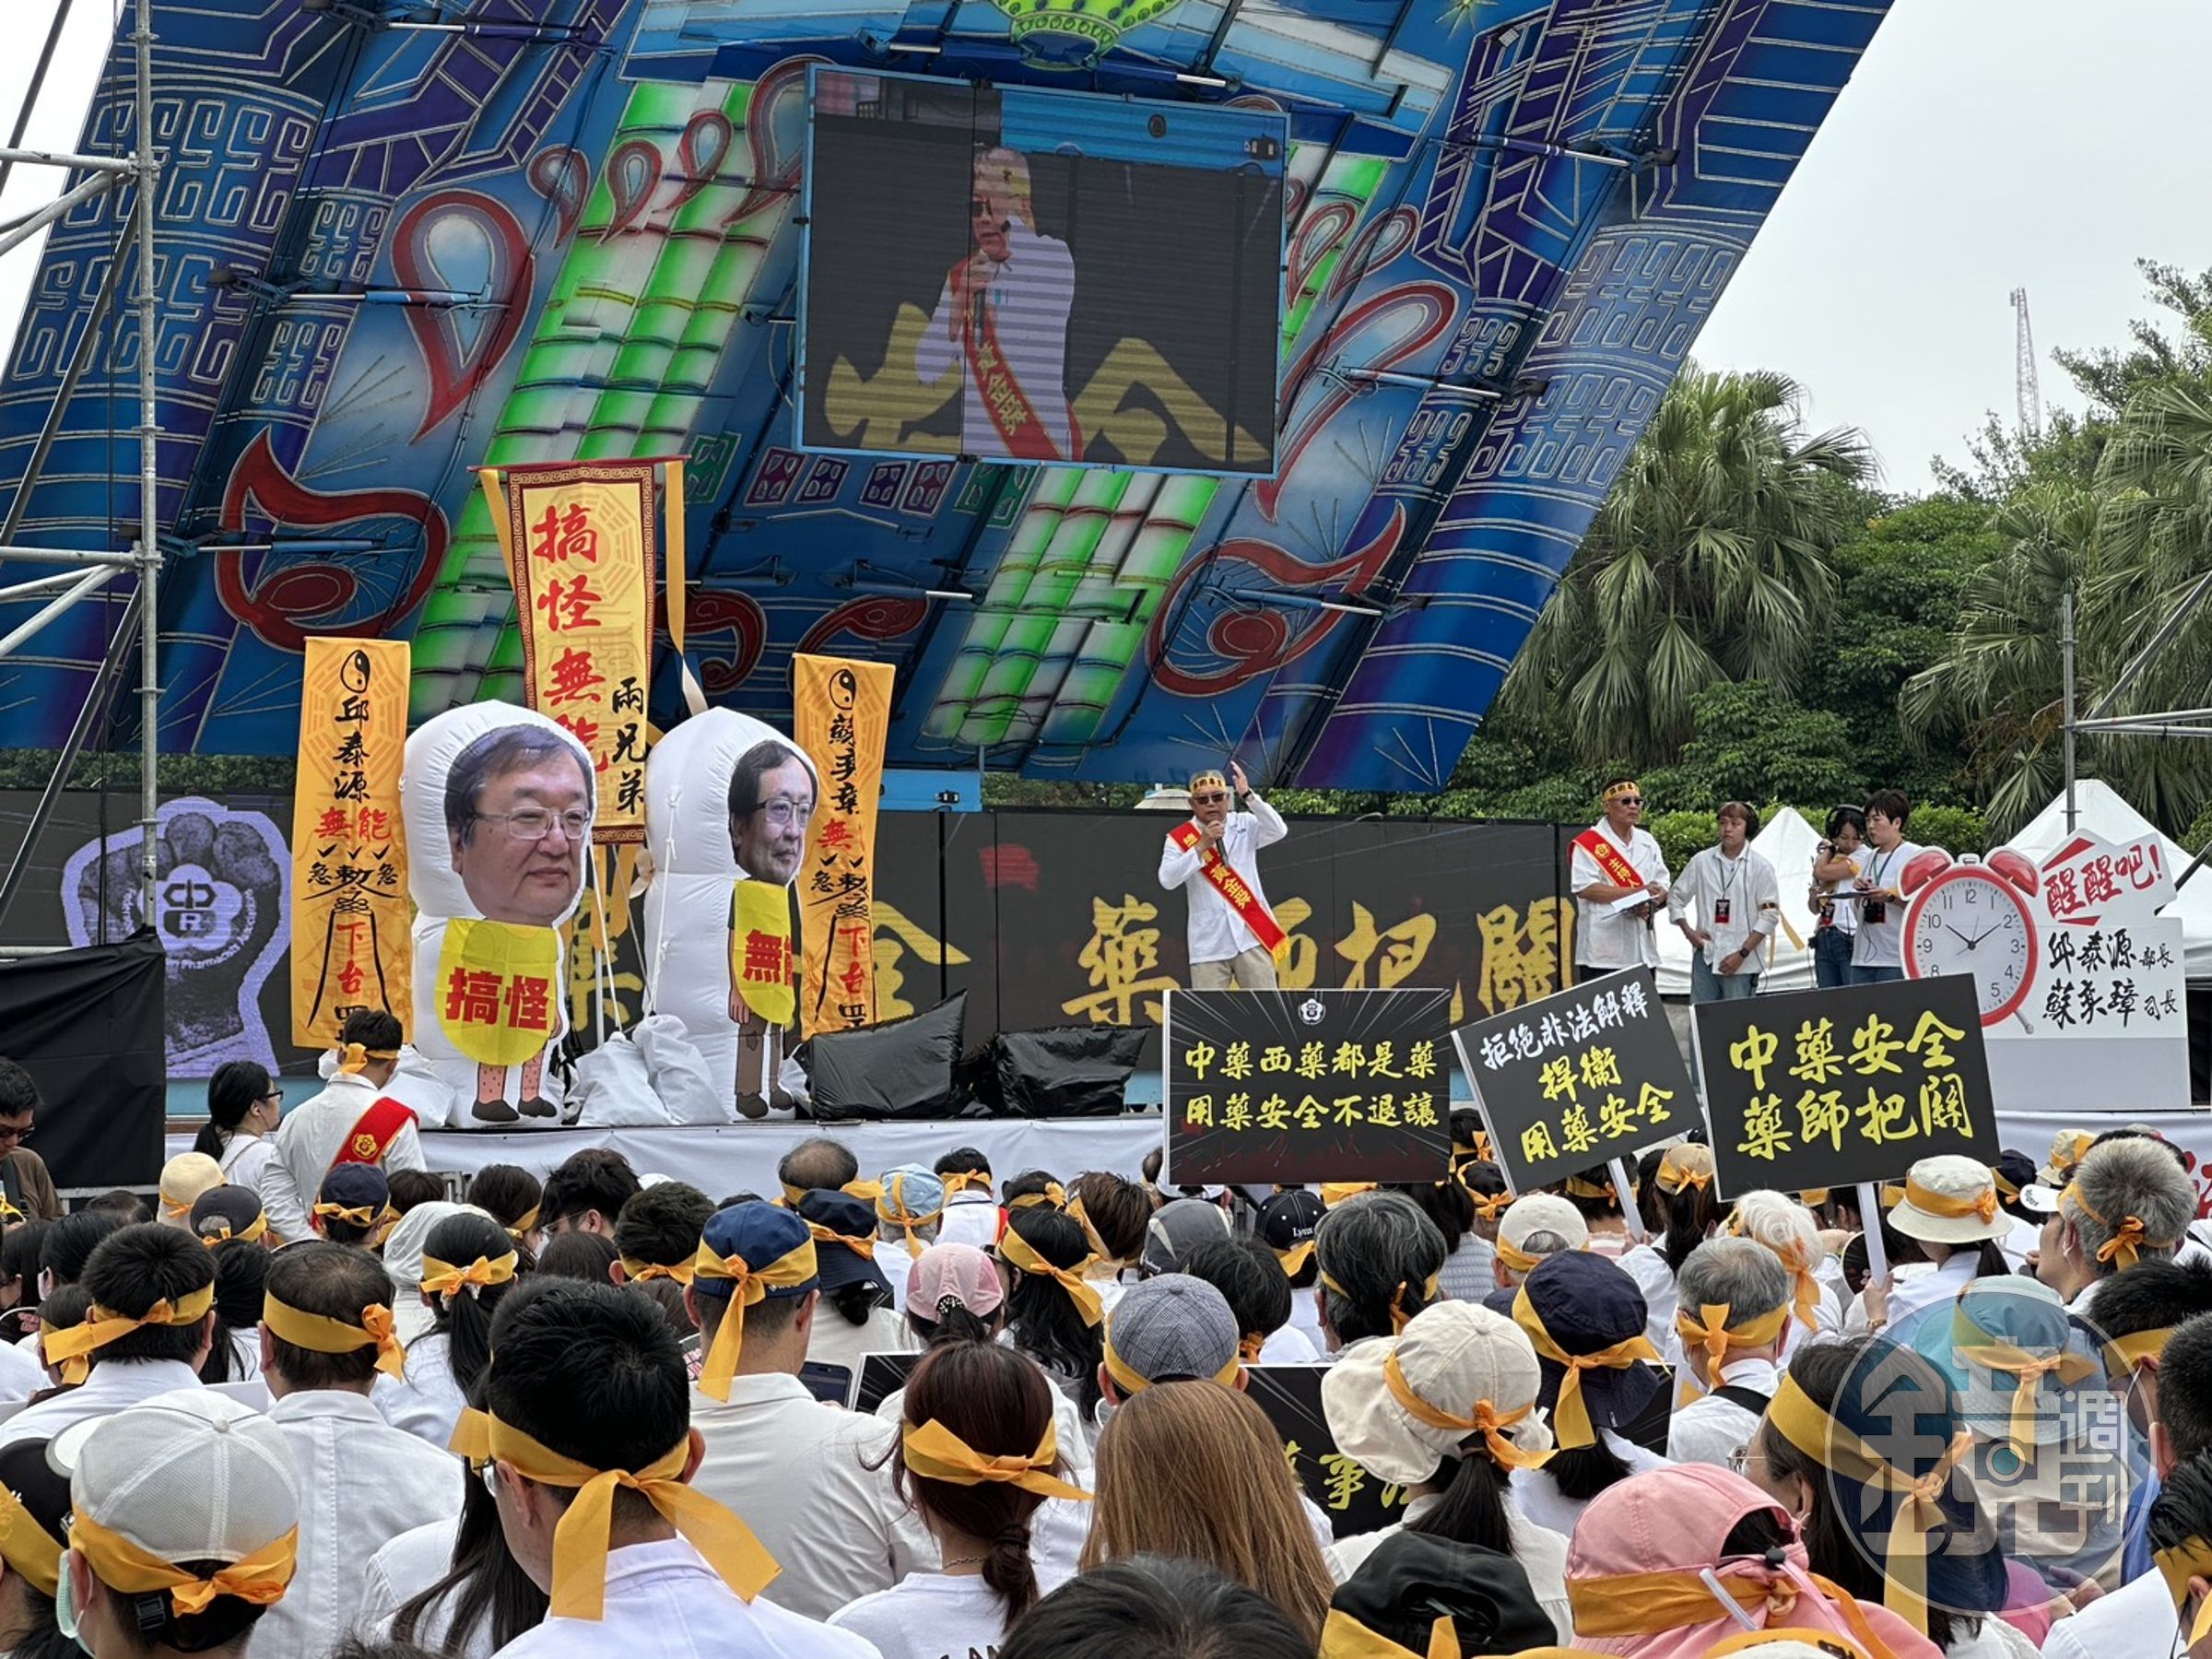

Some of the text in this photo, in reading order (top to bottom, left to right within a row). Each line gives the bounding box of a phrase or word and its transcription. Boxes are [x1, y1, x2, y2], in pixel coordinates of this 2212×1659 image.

[333, 695, 371, 804] 邱泰源
[612, 677, 645, 815] 兩兄弟
[313, 806, 392, 843] 無能
[816, 818, 853, 851] 無
[1943, 895, 1953, 910] 11
[1965, 888, 1977, 904] 12
[1927, 913, 1942, 929] 10
[2003, 914, 2013, 929] 2
[336, 921, 367, 995] 下台
[838, 925, 867, 994] 下台
[1923, 938, 1933, 953] 9
[2010, 939, 2020, 954] 3
[1991, 982, 2001, 998] 5
[2005, 964, 2014, 980] 4
[445, 966, 550, 1031] 搞怪
[1479, 981, 1649, 1071] 拒絕非法解釋
[1184, 1040, 1439, 1081] 中藥西藥都是藥
[1729, 1009, 1967, 1091] 中藥安全
[1538, 1044, 1623, 1102] 捍衛
[1185, 1090, 1440, 1132] 用藥安全不退讓
[1521, 1081, 1675, 1164] 用藥安全
[1736, 1072, 1974, 1161] 藥師把關
